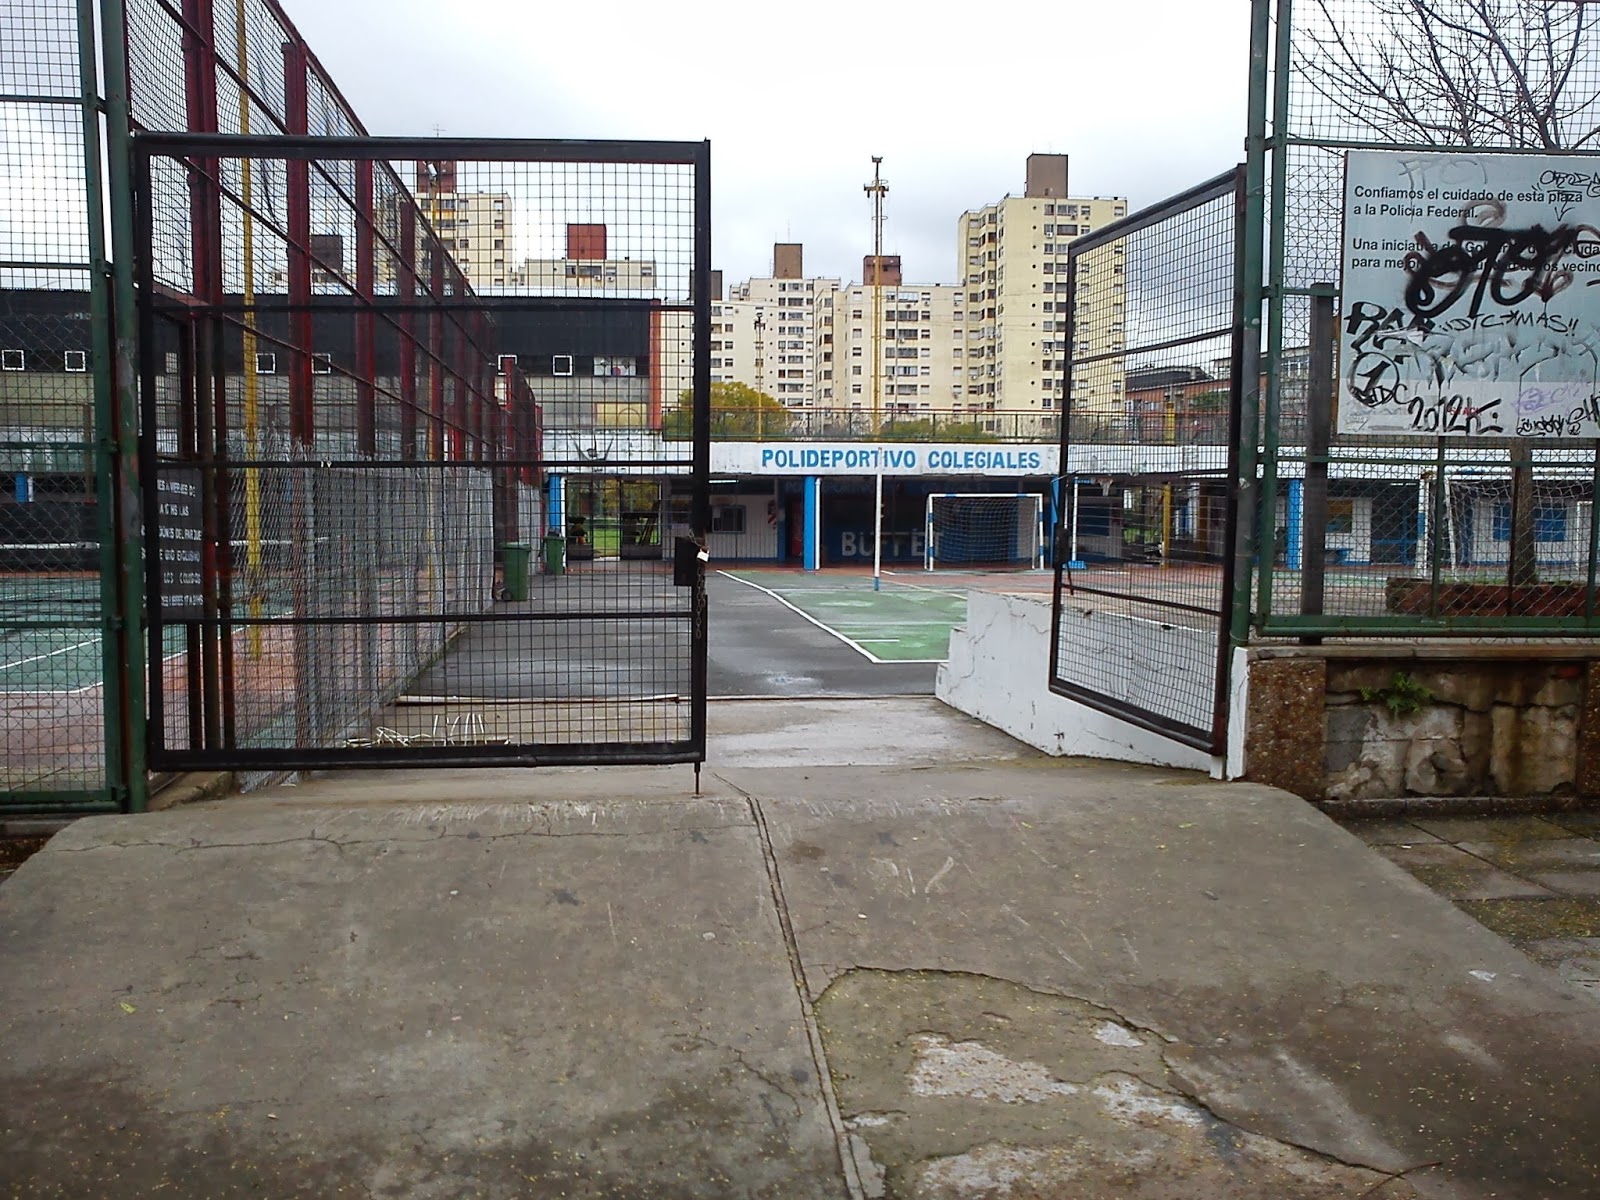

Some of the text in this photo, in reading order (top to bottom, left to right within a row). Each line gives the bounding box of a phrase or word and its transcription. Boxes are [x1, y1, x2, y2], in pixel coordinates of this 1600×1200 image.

[1354, 185, 1583, 204] Confiamos el cuidado de esta plaza
[1353, 206, 1362, 216] a
[1365, 203, 1376, 216] la
[1427, 205, 1478, 219] Federal.
[1352, 238, 1379, 251] Una
[1351, 259, 1381, 273] para
[762, 449, 1041, 469] POLIDEPORTIVO COLEGIALES
